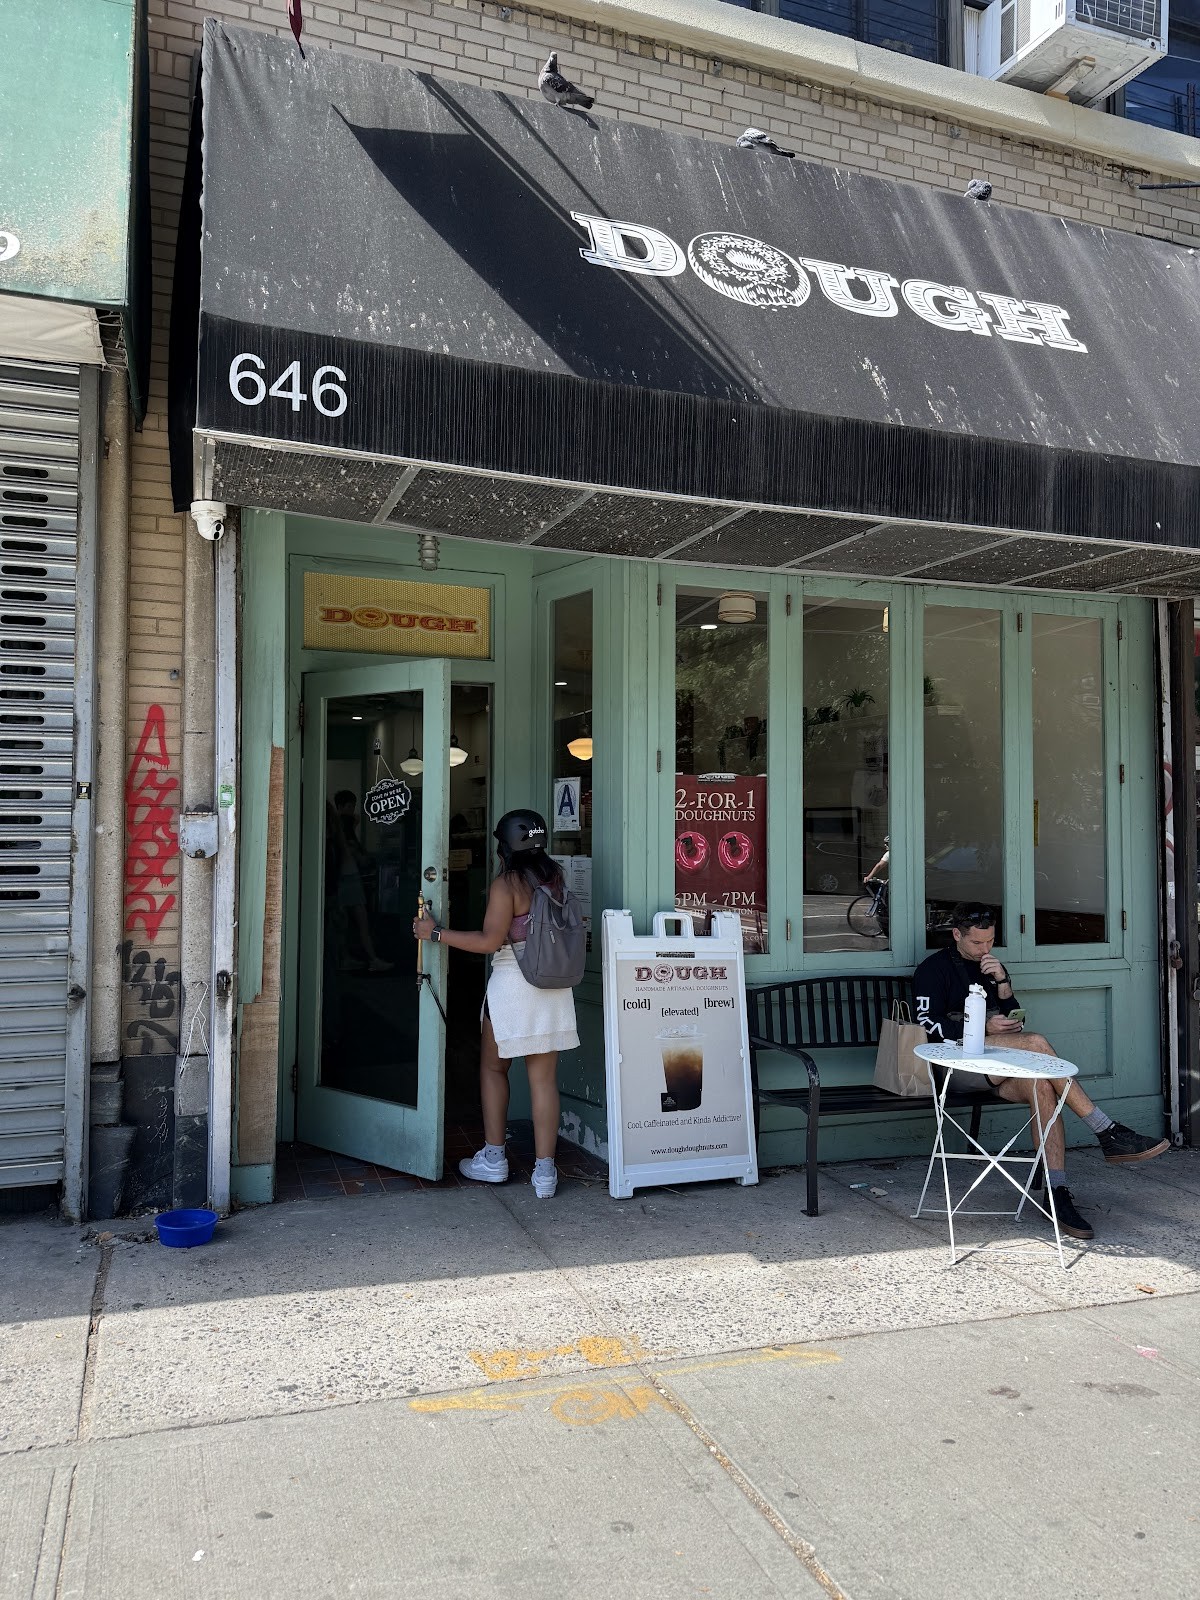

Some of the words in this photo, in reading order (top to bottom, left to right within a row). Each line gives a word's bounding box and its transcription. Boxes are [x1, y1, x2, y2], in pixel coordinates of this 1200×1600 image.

[570, 211, 1090, 353] DOUGH
[228, 352, 348, 418] 646
[319, 606, 478, 633] DOUGH
[370, 793, 406, 814] OPEN
[558, 784, 575, 815] A
[675, 810, 756, 821] DOUGHNUTS
[722, 891, 756, 906] 7PM
[634, 963, 728, 984] DOUGH
[623, 999, 651, 1010] [cold]
[661, 1007, 699, 1017] [elevated]
[704, 998, 735, 1009] [brew]
[643, 1118, 679, 1129] Caffeinated
[680, 1117, 692, 1126] and
[693, 1116, 712, 1125] Kinda
